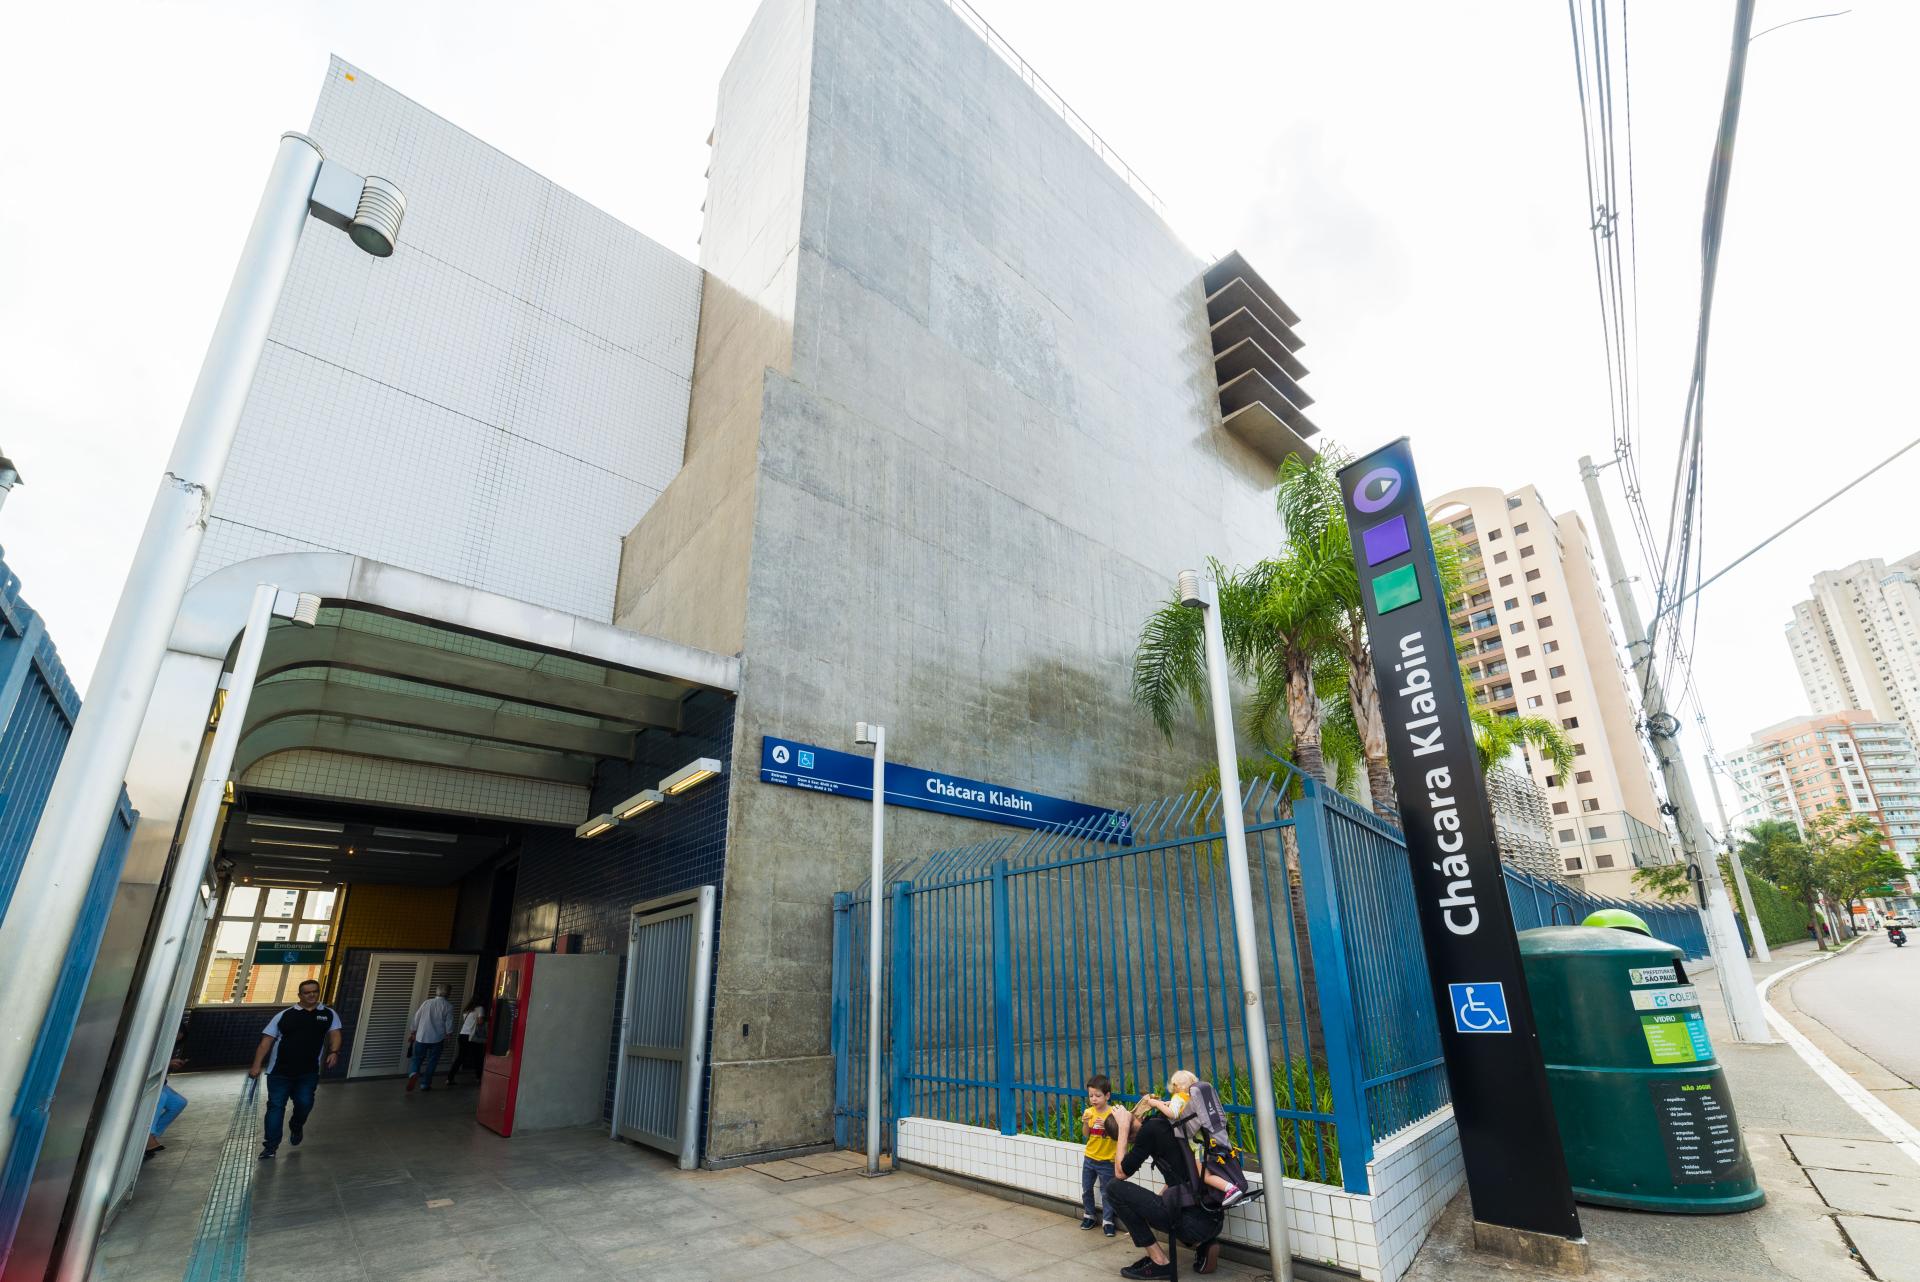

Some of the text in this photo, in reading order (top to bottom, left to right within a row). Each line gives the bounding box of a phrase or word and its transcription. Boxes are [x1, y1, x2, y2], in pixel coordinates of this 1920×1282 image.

[776, 750, 785, 760] A
[1394, 631, 1480, 936] Chácara Klabin
[926, 778, 1033, 812] Chácara Klabin
[1645, 974, 1659, 982] SÃO
[1653, 1015, 1676, 1023] VIDRO
